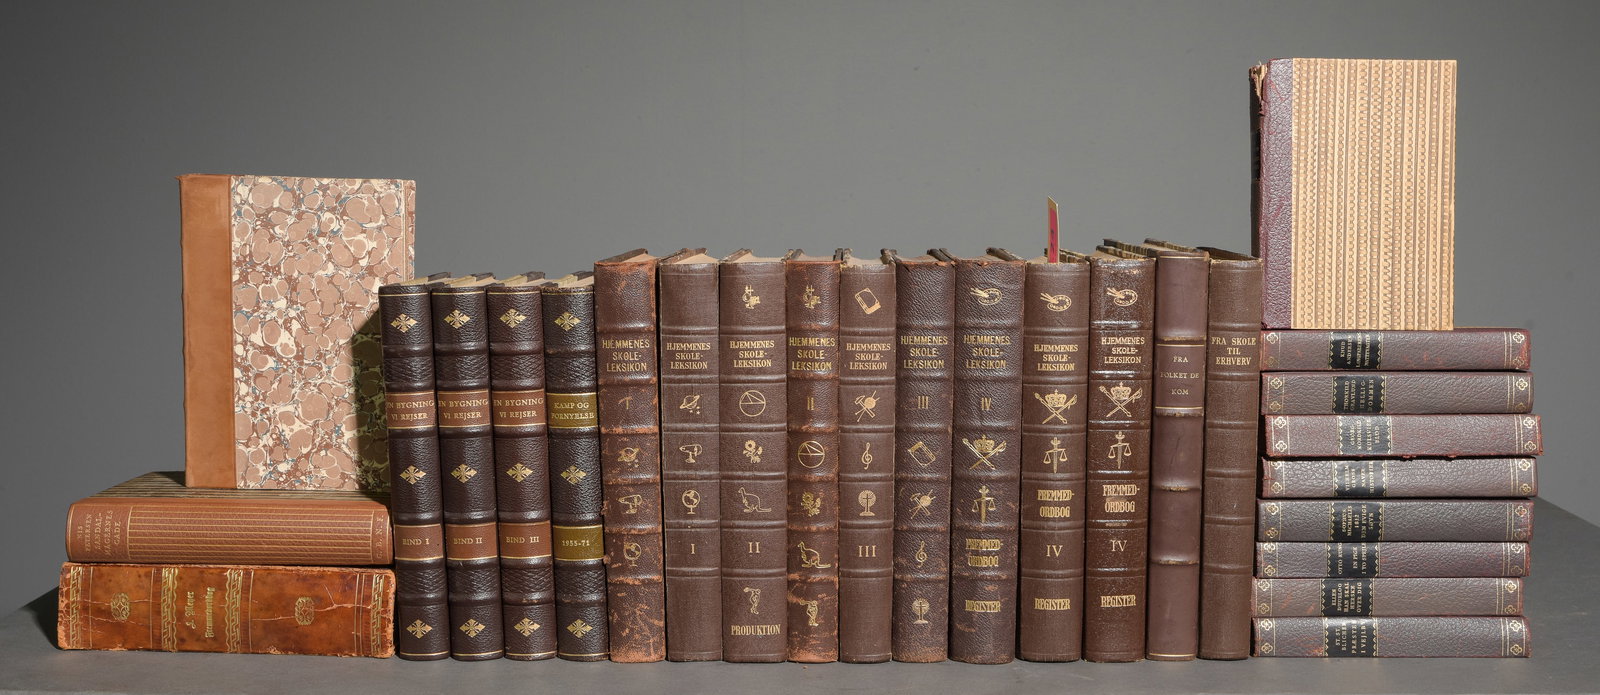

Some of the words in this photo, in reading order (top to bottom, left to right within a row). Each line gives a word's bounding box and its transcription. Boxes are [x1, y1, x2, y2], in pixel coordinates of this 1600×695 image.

[602, 339, 650, 348] HJEMMENES
[730, 340, 775, 349] HJEMMENES
[789, 336, 836, 347] HJEMMENES
[901, 335, 948, 345] HJEMMENES
[963, 334, 1011, 345] HJEMMENES
[1101, 336, 1145, 345] HJEMMENES
[1211, 337, 1227, 345] FRA
[1231, 337, 1257, 346] SKOLE
[666, 342, 711, 351] HJEMMENES
[846, 343, 891, 351] HJEMMENES
[1034, 344, 1078, 352] HJEMMENES
[1226, 347, 1241, 355] TIL
[612, 351, 642, 361] SKOLE-
[675, 352, 704, 360] SKOLE-
[739, 350, 768, 358] SKOLE-
[797, 349, 828, 359] SKOLE-
[855, 352, 884, 360] SKOLE-
[910, 348, 939, 357] SKOLE-
[972, 347, 1004, 357] SKOLE-
[733, 359, 772, 368] LEKSIKON
[903, 359, 945, 369] LEKSIKON
[966, 359, 1006, 369] LEKSIKON
[1104, 355, 1142, 364] LEKSIKON
[1215, 356, 1252, 365] ERHVERV
[606, 362, 647, 372] LEKSIKON
[670, 361, 708, 370] LEKSIKON
[791, 361, 832, 371] LEKSIKON
[849, 362, 888, 370] LEKSIKON
[1037, 362, 1075, 371] LEKSIKON
[396, 400, 435, 409] BYGNING
[449, 399, 488, 408] BYGNING
[505, 397, 544, 406] BYGNING
[807, 397, 814, 410] II
[917, 395, 929, 409] III
[981, 397, 992, 410] IV
[400, 412, 428, 421] REJSER
[454, 411, 482, 420] REJSER
[510, 410, 537, 419] REJSER
[1037, 489, 1075, 501] FREMMED-
[1102, 484, 1140, 496] FREMMED-
[1039, 506, 1071, 518] ORDBOG
[1104, 501, 1135, 513] ORDBOG
[425, 537, 430, 545] I
[530, 535, 539, 543] III
[561, 539, 590, 547] 1955-71
[965, 538, 1004, 550] FREMMED-
[690, 543, 696, 554] I
[748, 541, 761, 553] II
[858, 545, 876, 557] III
[1046, 544, 1063, 557] IV
[1110, 540, 1127, 552] IV
[968, 555, 999, 567] ORDBOG
[965, 600, 1001, 612] REGISTER
[1034, 598, 1071, 610] REGISTER
[1101, 595, 1136, 607] REGISTER
[731, 624, 781, 636] PRODUKTION
